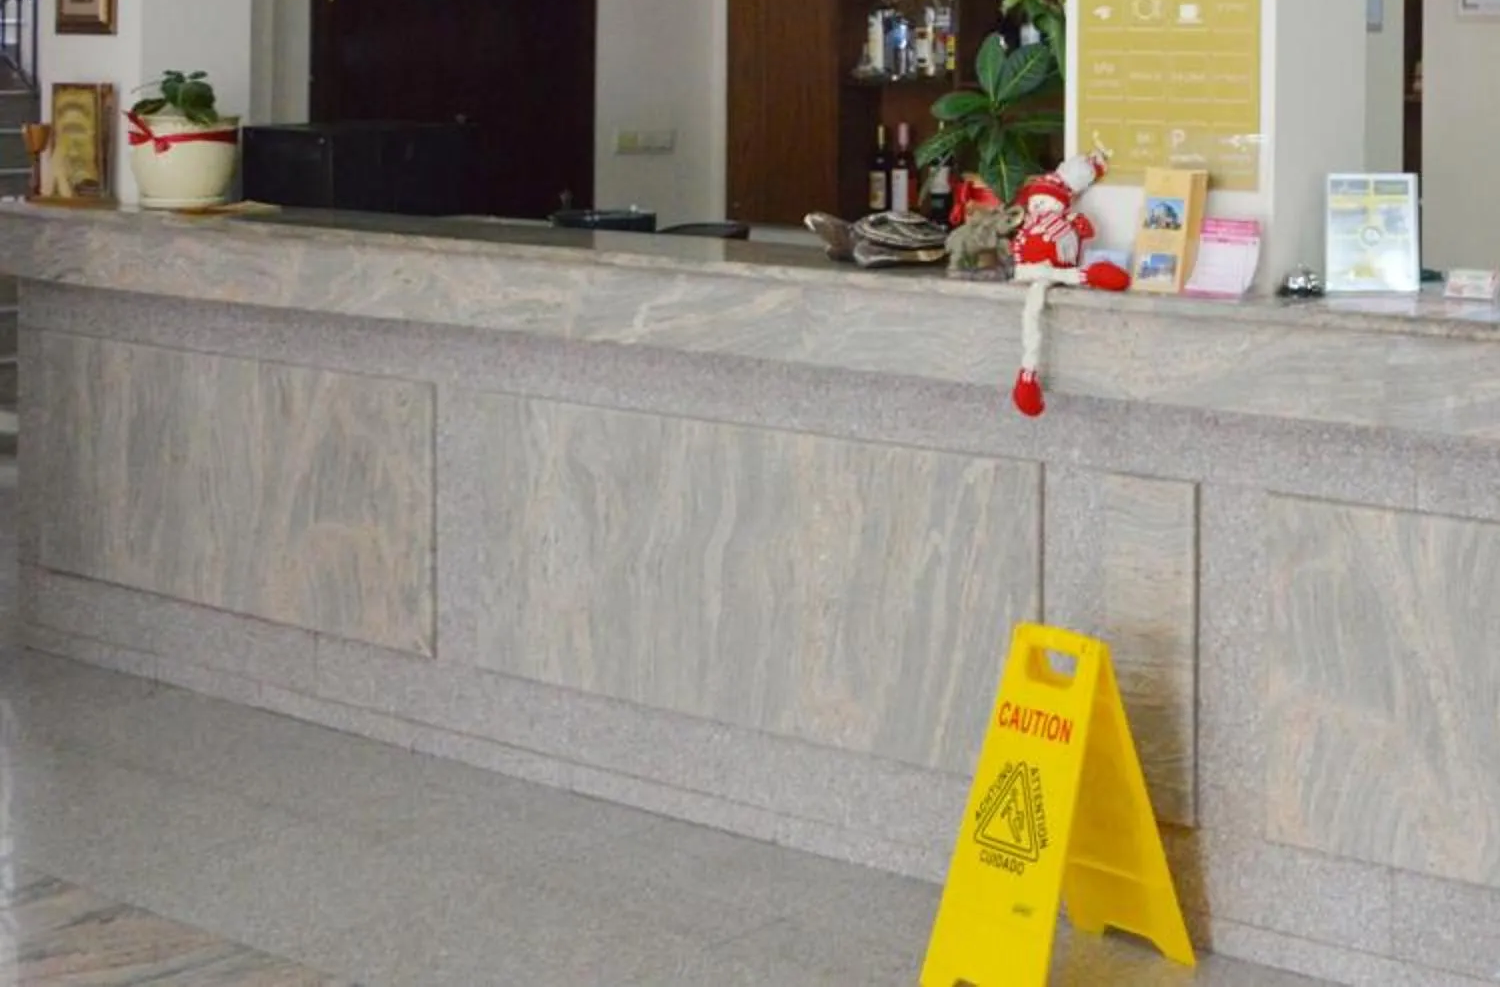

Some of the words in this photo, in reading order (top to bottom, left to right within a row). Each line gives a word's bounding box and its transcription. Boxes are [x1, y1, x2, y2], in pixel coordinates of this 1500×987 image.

[998, 700, 1073, 744] CAUTION
[1030, 767, 1049, 849] ATTENTION
[979, 849, 1025, 876] CUIDADO
